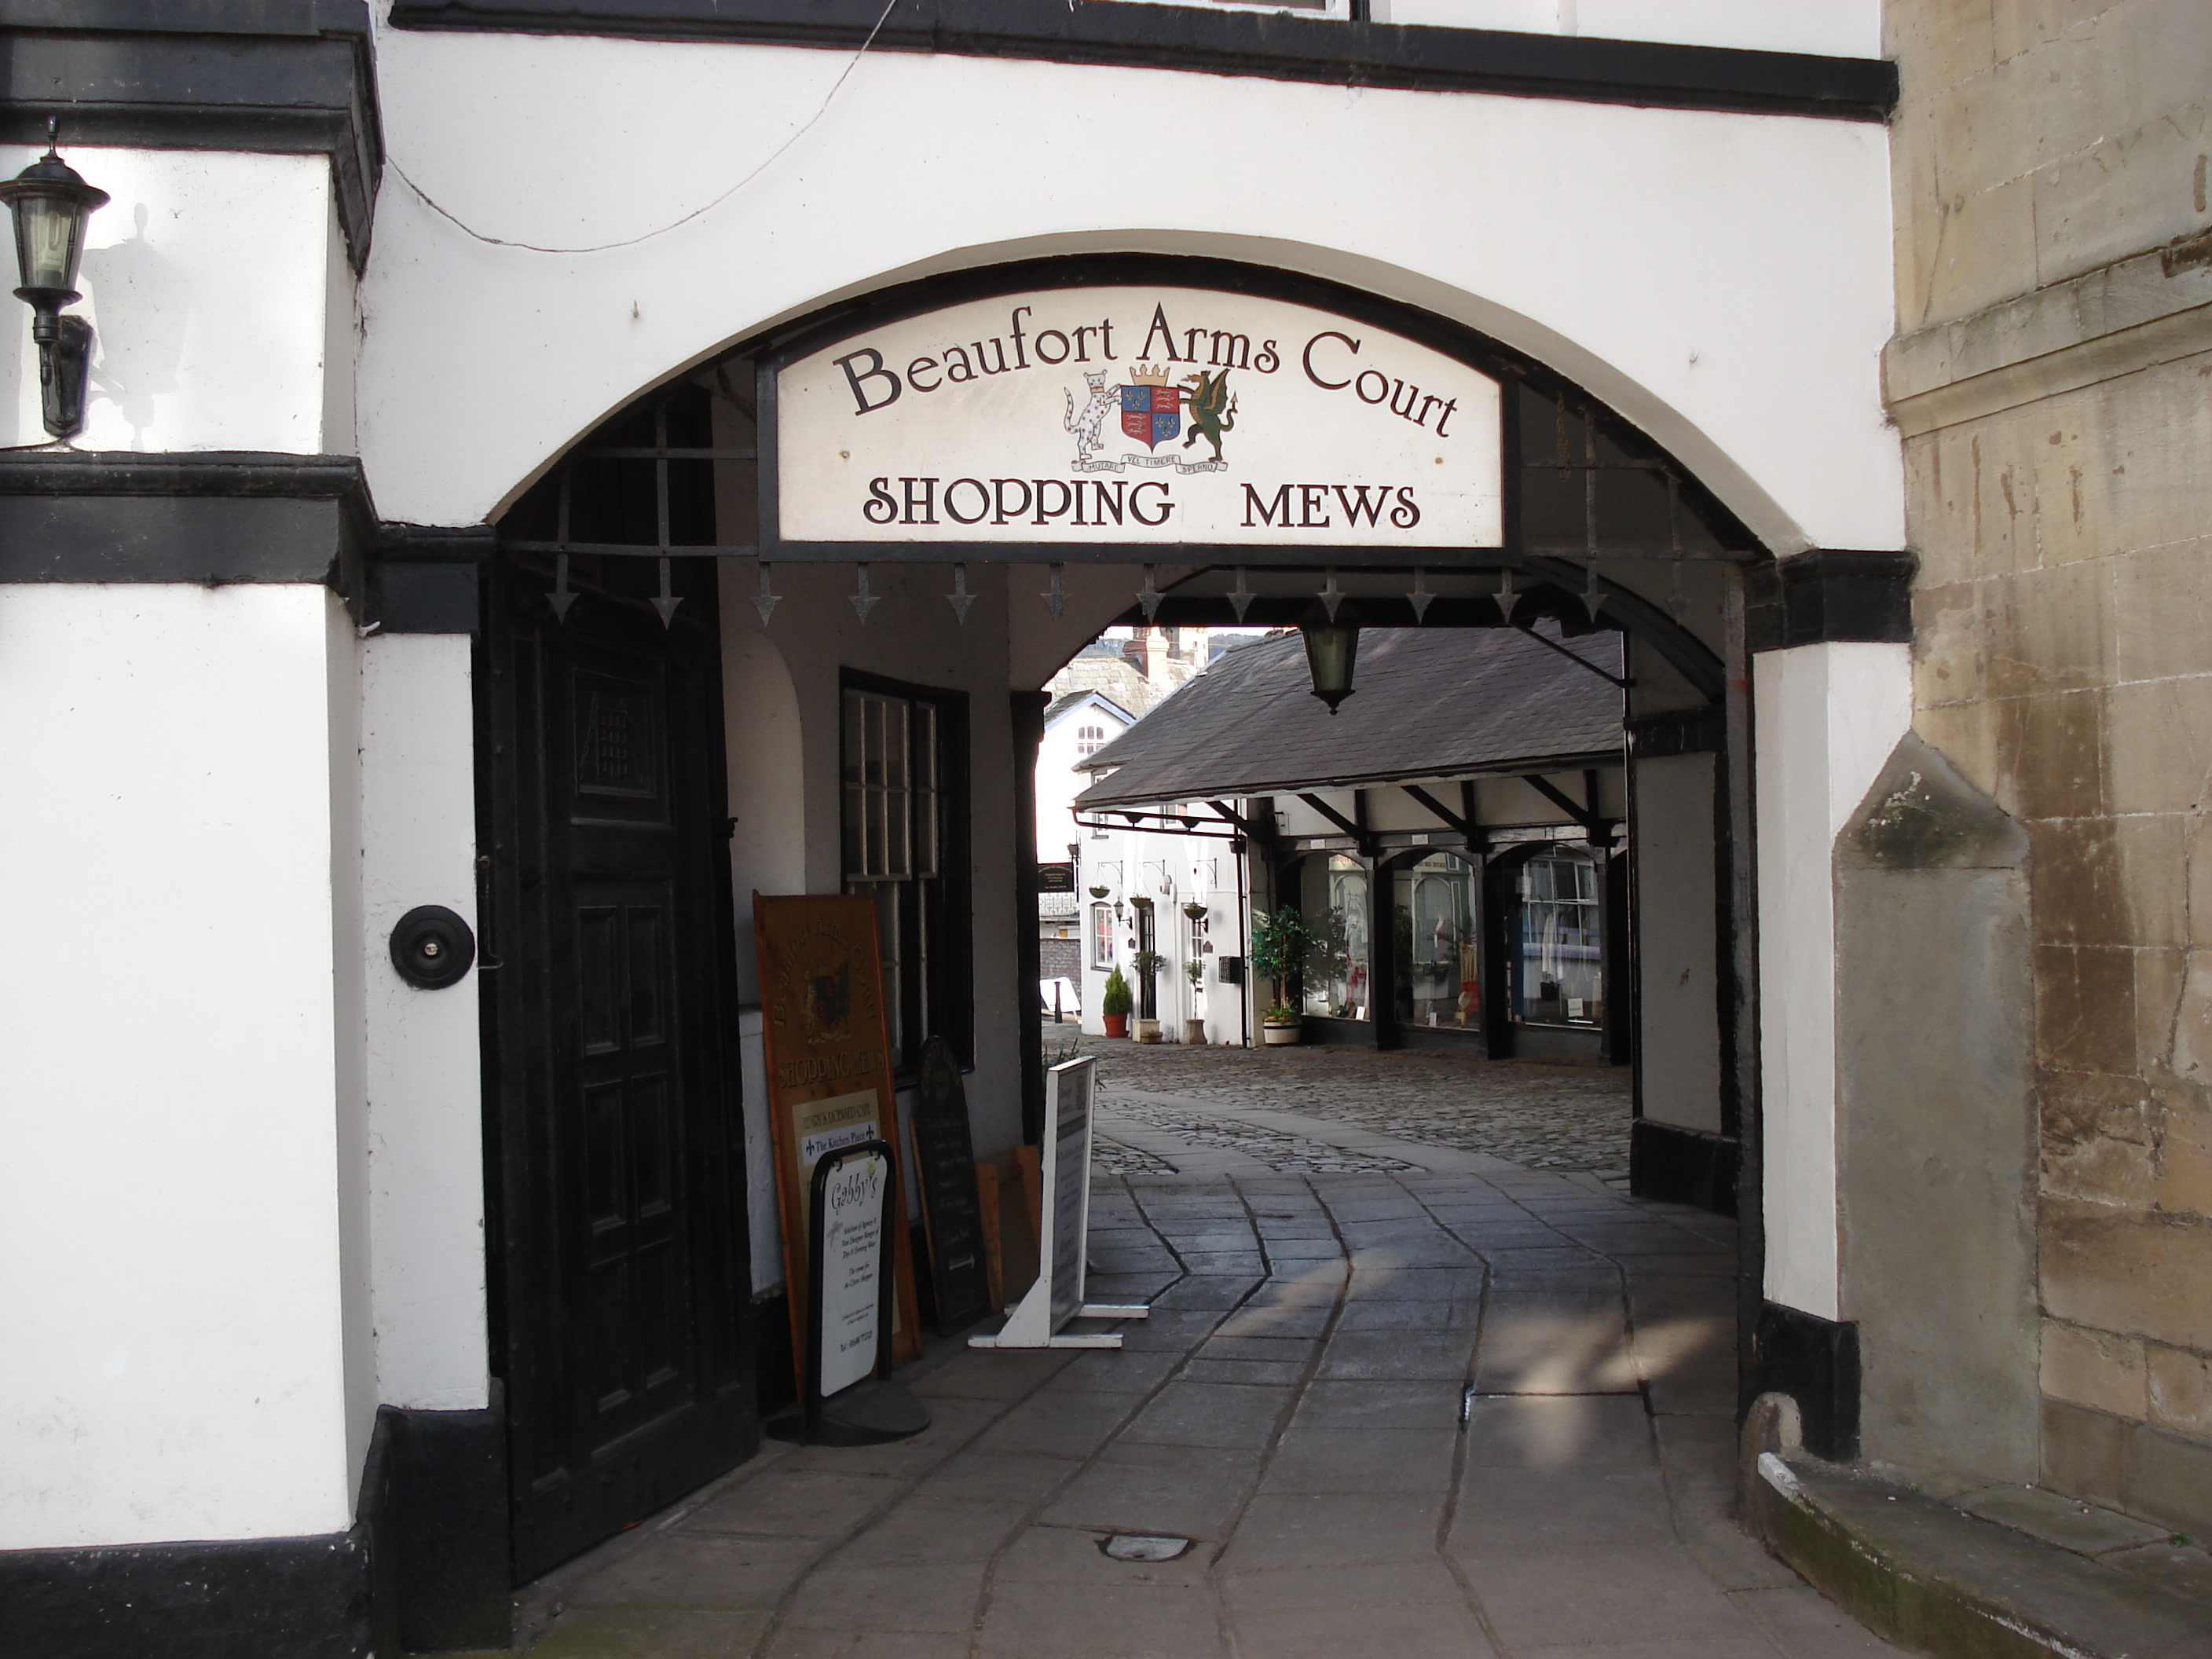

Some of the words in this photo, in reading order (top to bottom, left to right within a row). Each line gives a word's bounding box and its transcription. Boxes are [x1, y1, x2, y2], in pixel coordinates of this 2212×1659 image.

[833, 306, 1117, 416] Beaufort
[1136, 302, 1281, 375] Arms
[1302, 331, 1458, 438] Court
[1089, 462, 1119, 471] MUTARE
[1127, 454, 1141, 465] VEL
[1145, 455, 1177, 466] TIMERE
[1182, 462, 1214, 473] SPERNO
[862, 476, 1176, 526] SHOPPING
[1240, 484, 1421, 529] MEWS
[778, 1051, 851, 1089] SHOPPING
[854, 1047, 886, 1076] MEWS
[815, 1141, 826, 1152] The
[827, 1135, 850, 1149] Kitchen
[850, 1131, 865, 1143] Place
[831, 1172, 878, 1217] Gabby's
